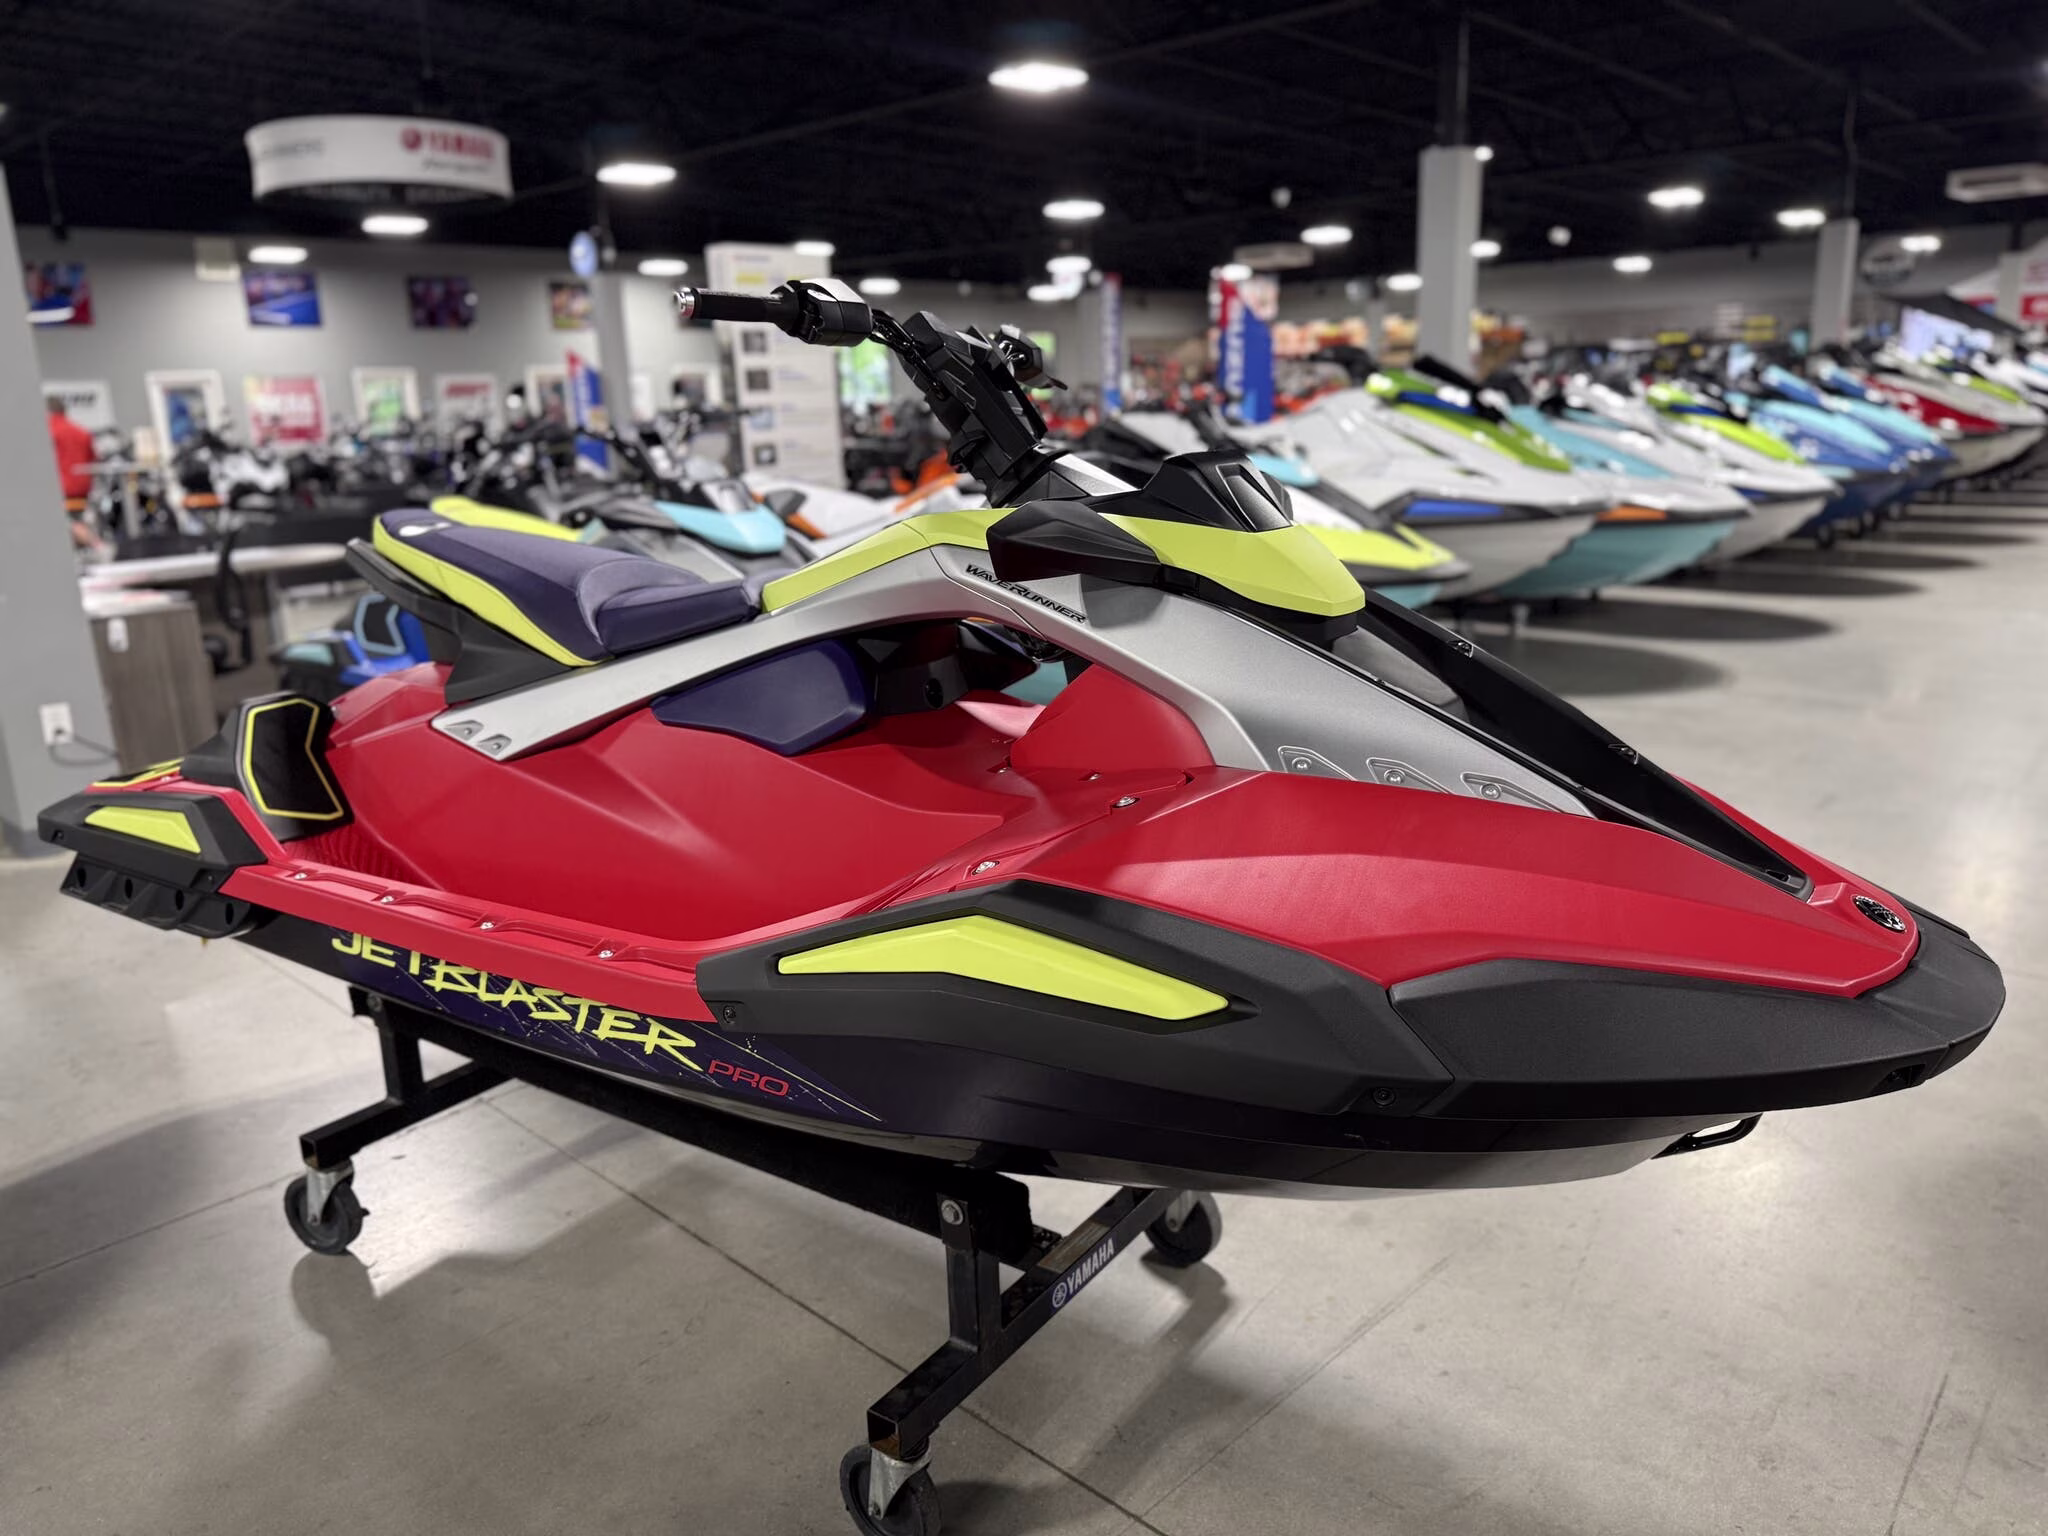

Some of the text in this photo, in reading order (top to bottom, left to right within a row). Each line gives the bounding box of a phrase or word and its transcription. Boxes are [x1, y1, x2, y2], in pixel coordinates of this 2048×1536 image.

[965, 564, 1087, 623] WAVERUNNER
[708, 1059, 790, 1097] PRO
[1066, 1237, 1115, 1295] YAMAHA
